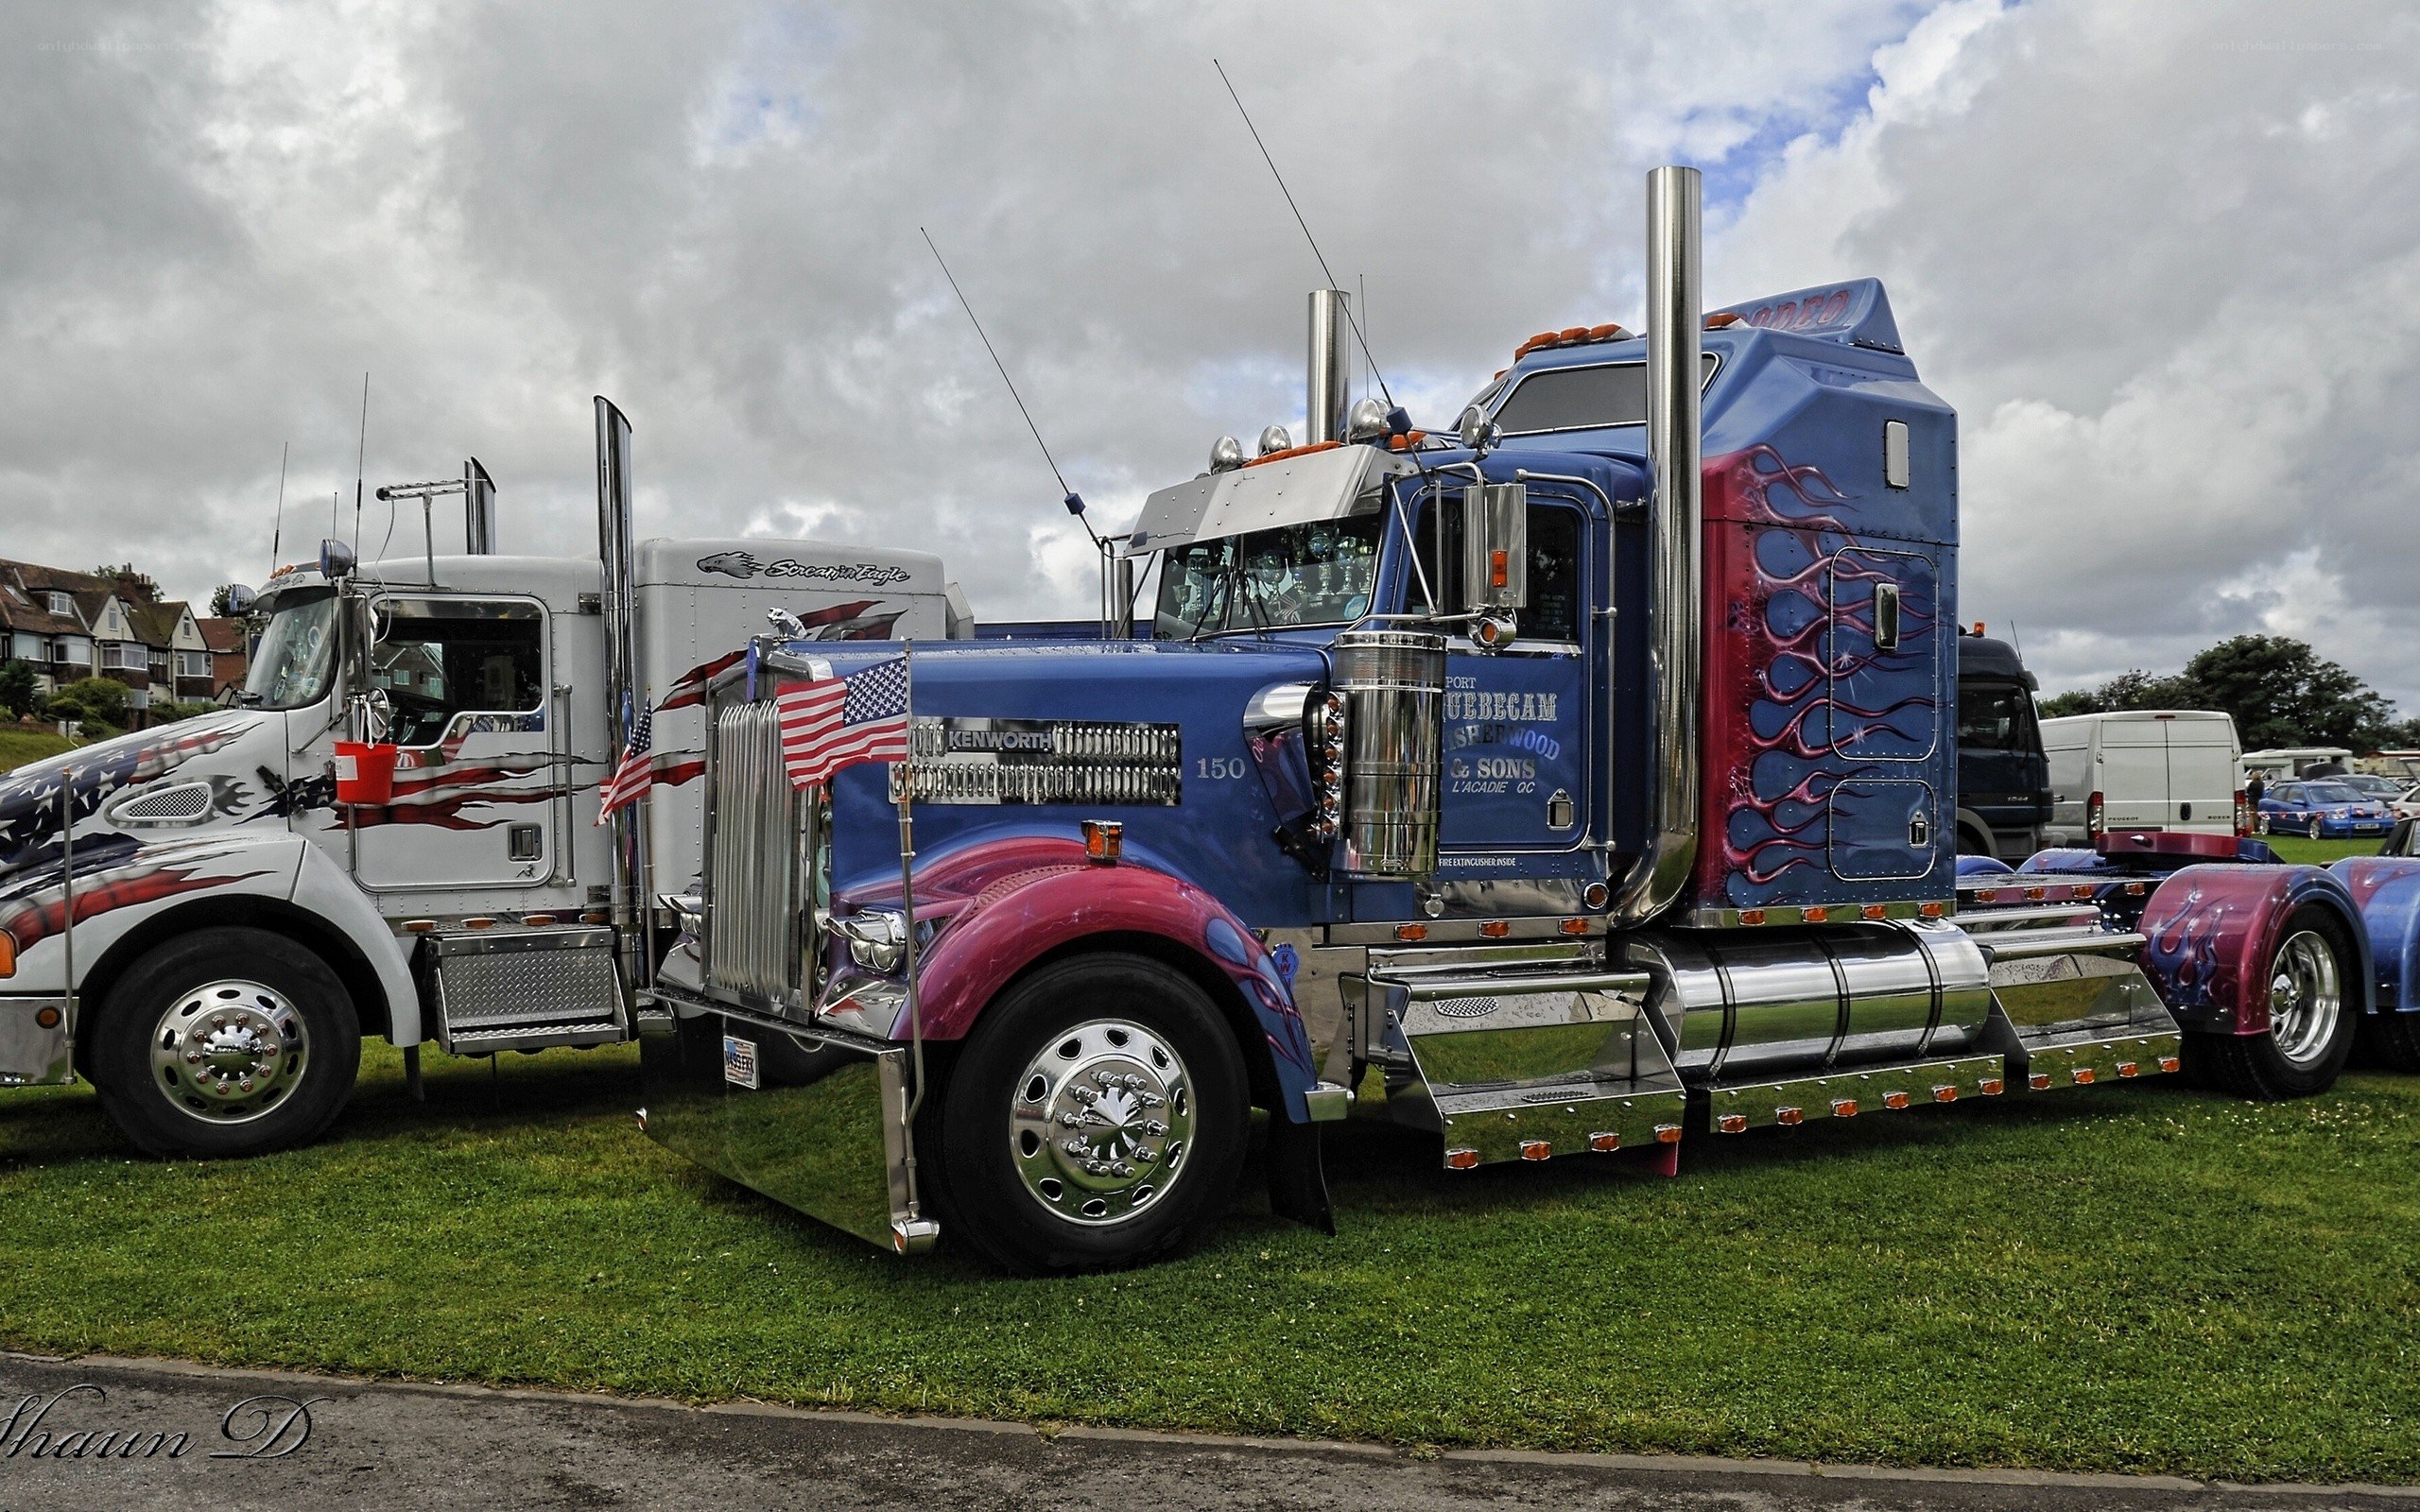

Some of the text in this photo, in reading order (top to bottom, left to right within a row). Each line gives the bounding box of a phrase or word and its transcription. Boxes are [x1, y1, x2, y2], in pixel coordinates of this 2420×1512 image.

[1741, 289, 1849, 330] ODEO
[856, 563, 910, 587] Eagle
[1443, 691, 1558, 722] UEBECAM
[948, 730, 1052, 748] KENWORTH
[1197, 757, 1246, 780] 150
[1450, 757, 1536, 780] & SONS
[1452, 781, 1536, 794] L'ACADIE QC
[1439, 857, 1516, 867] FIRE EXTINGUISHER INSIDE
